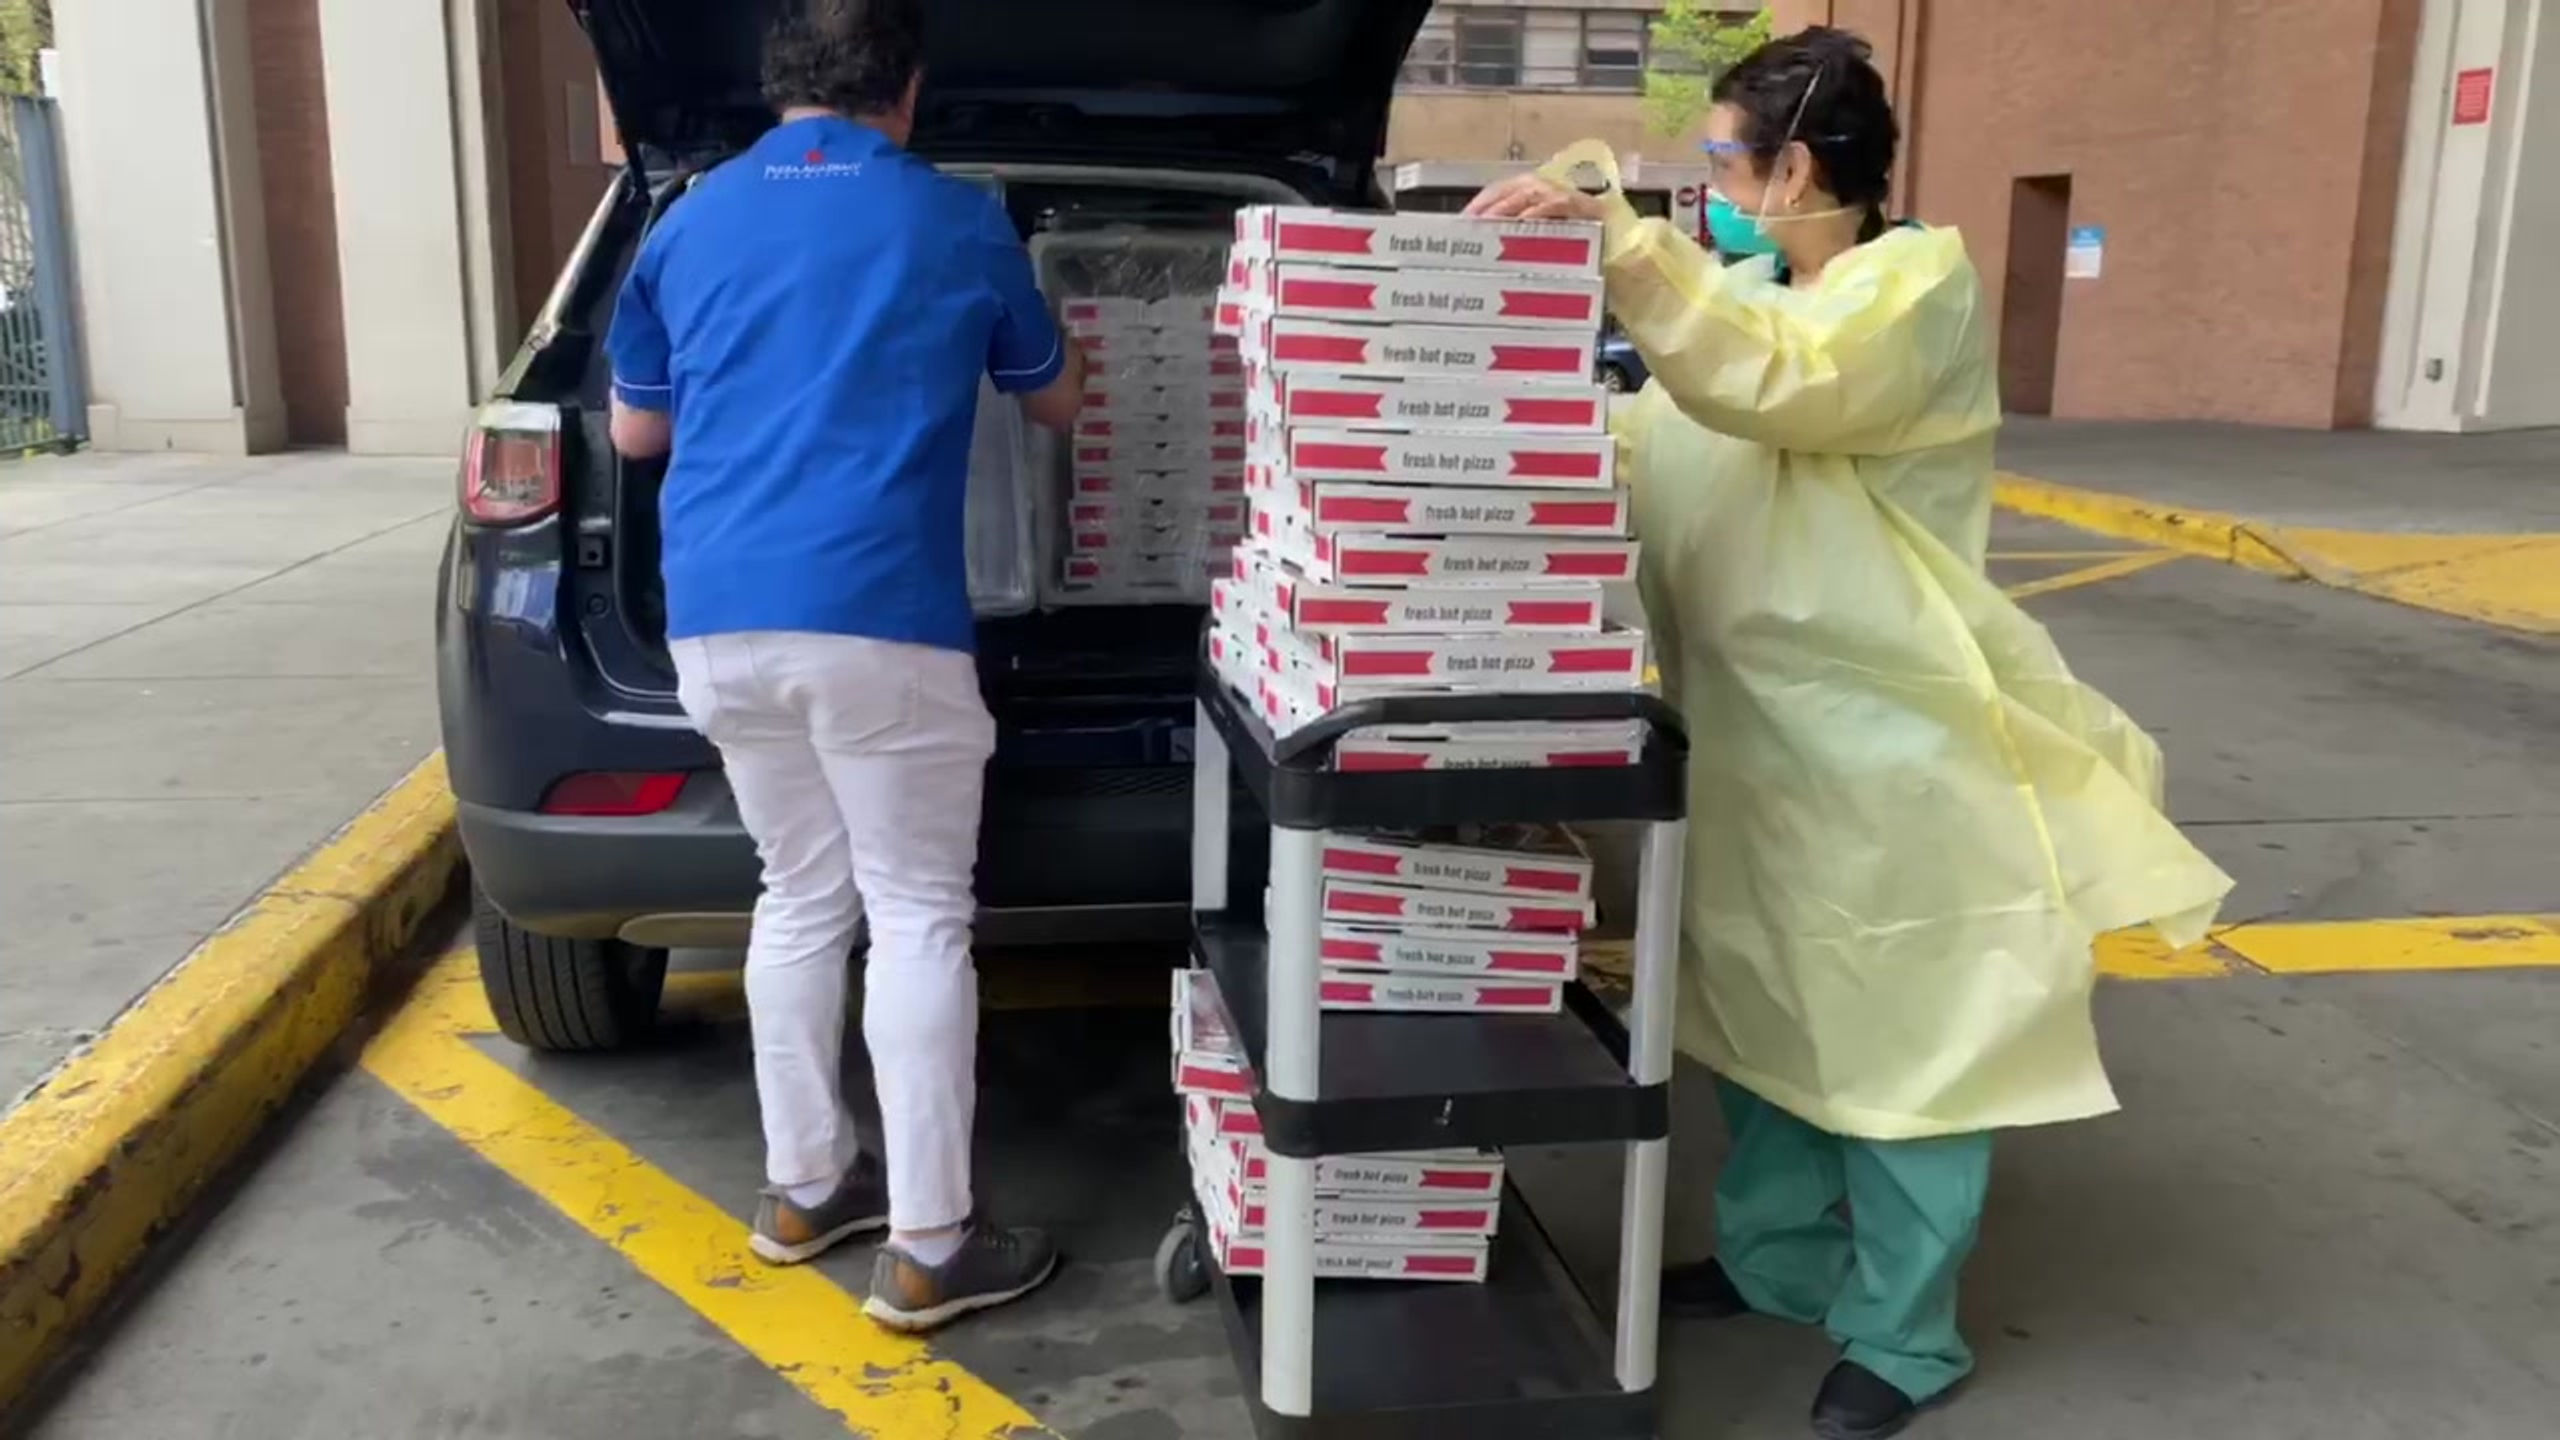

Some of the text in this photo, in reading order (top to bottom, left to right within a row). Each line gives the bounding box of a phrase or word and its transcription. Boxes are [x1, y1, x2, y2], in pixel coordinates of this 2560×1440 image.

[1390, 234, 1484, 257] fresh hot pizza
[1392, 290, 1484, 312] fresh hot pizza
[1384, 346, 1476, 366] fresh hot pizza
[1397, 400, 1490, 419] fresh hot pizza
[1403, 452, 1495, 472] fresh hot pizza
[1426, 505, 1515, 522] fresh hot pizza
[1443, 556, 1531, 573] fresh hot pizza
[1405, 604, 1493, 624] fresh hot pizza
[1447, 654, 1535, 672] fresh hot pizza
